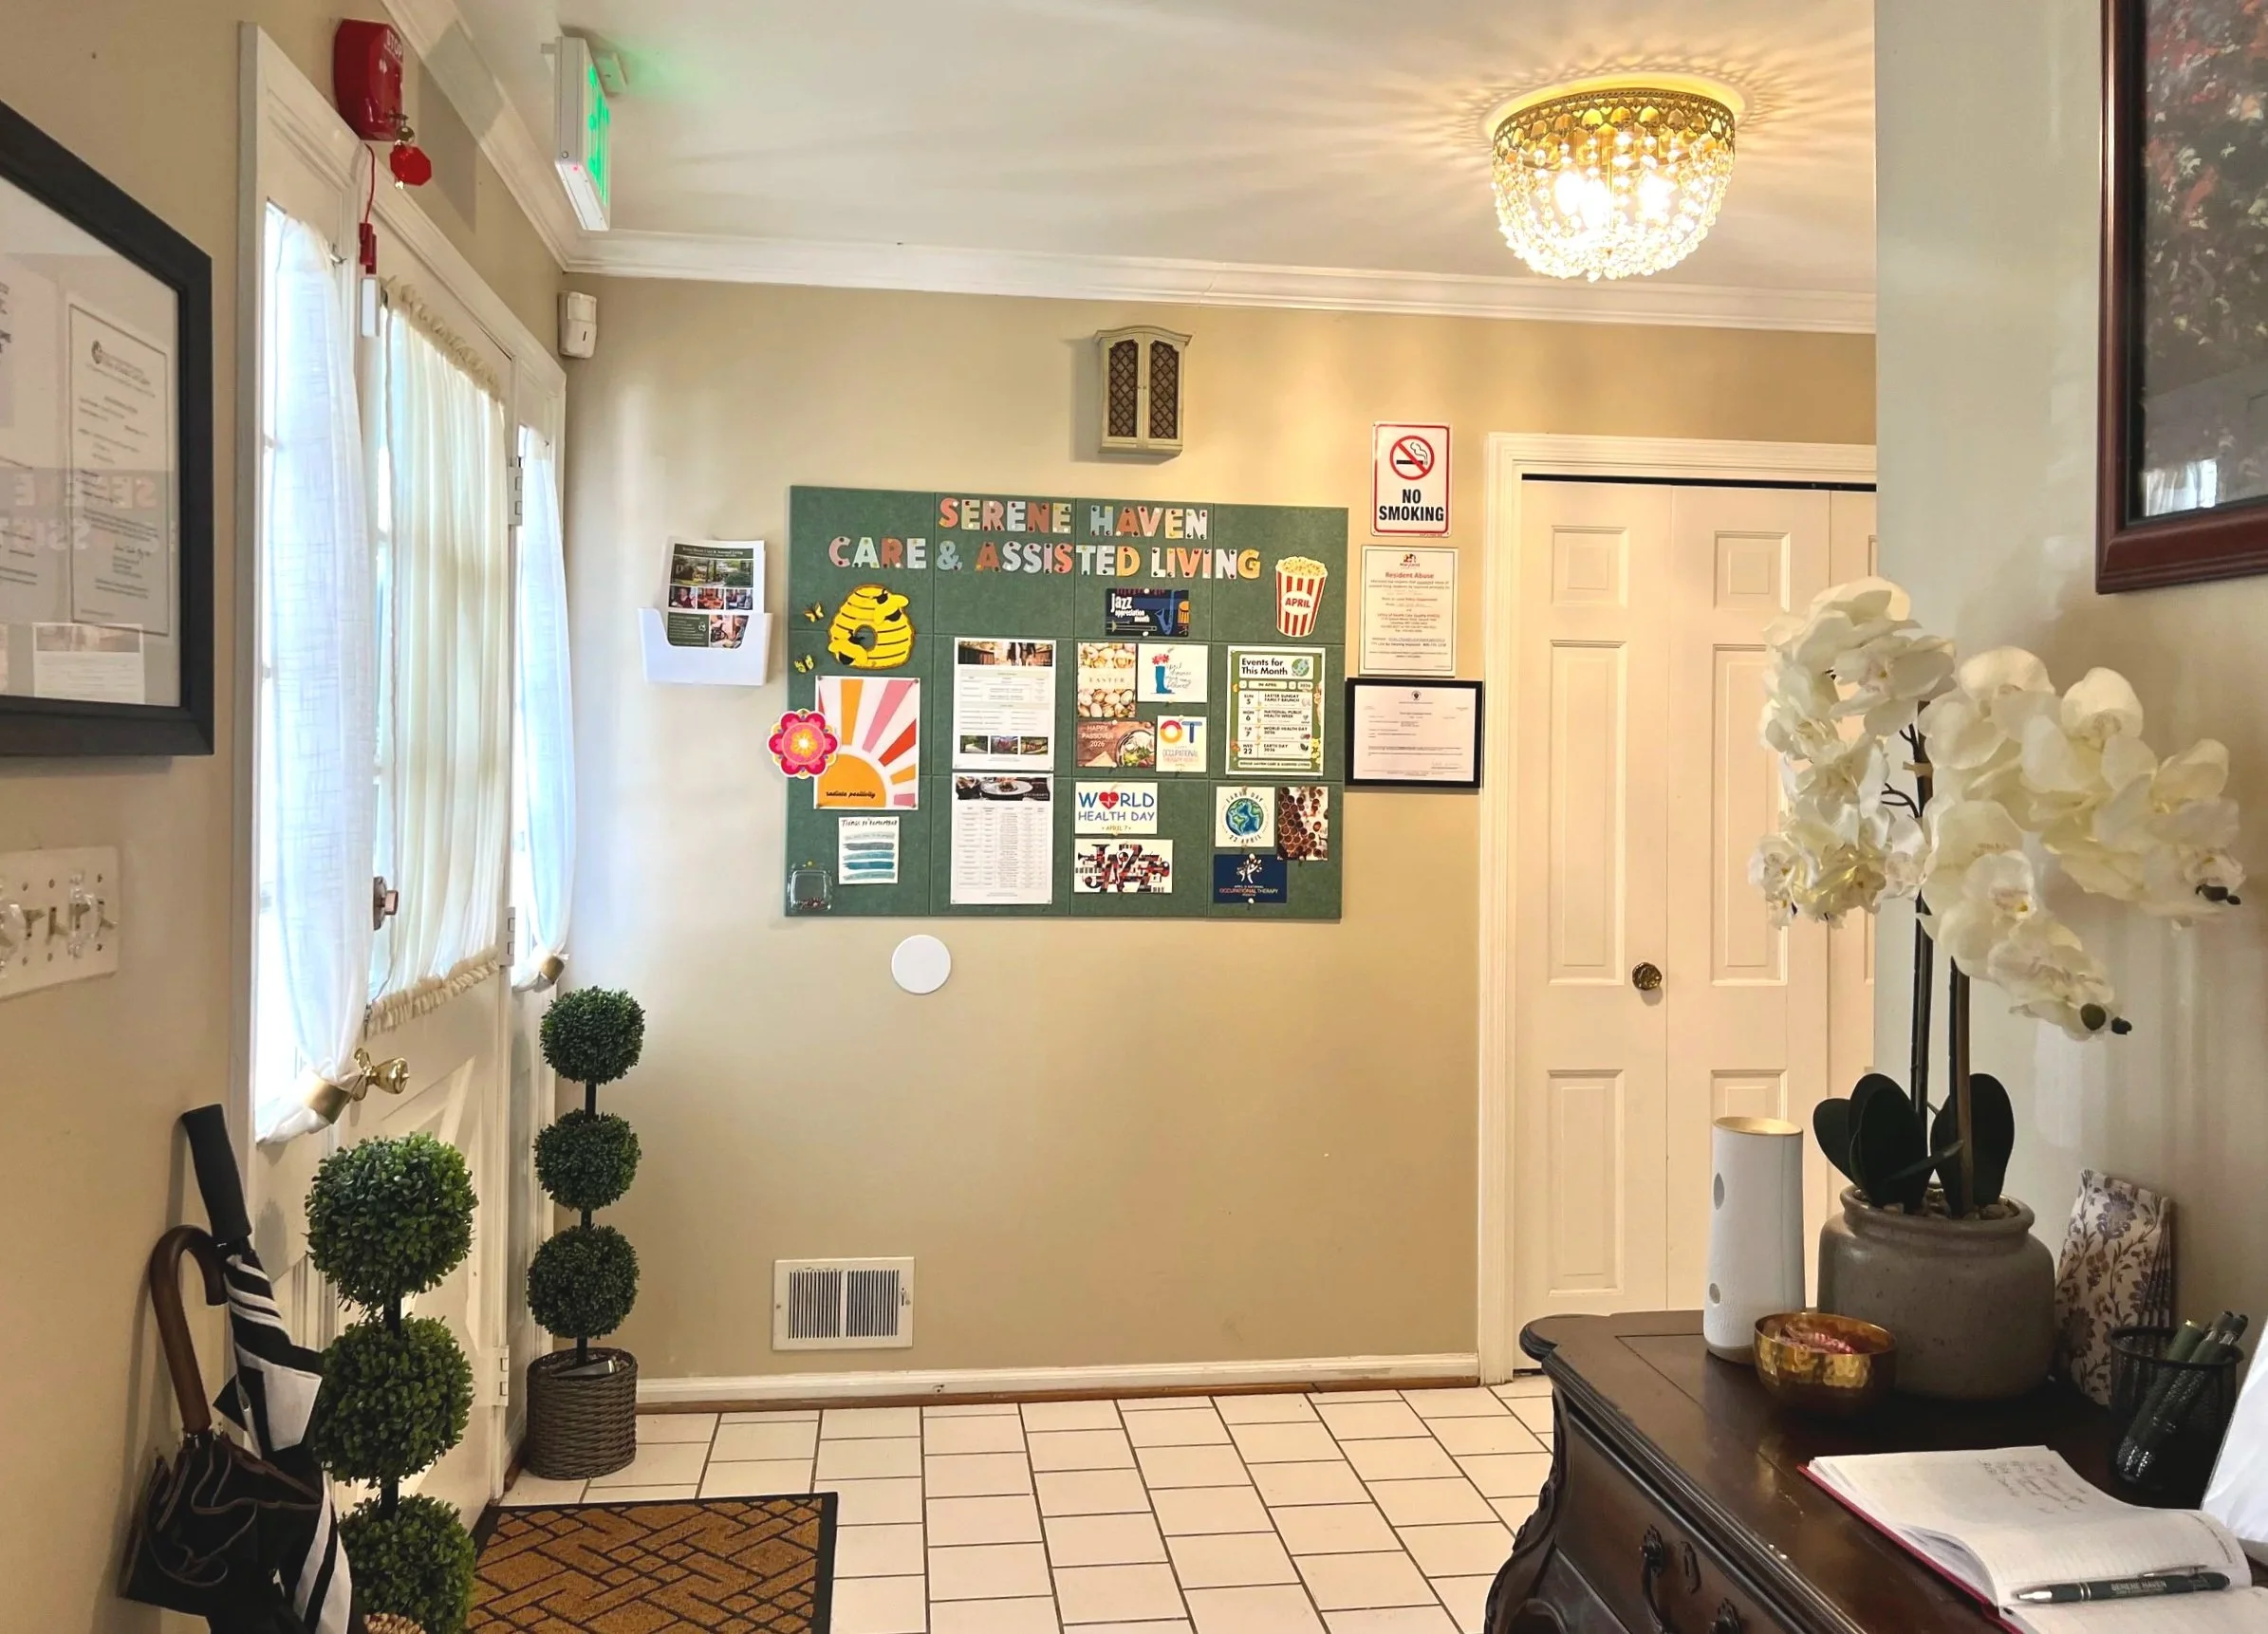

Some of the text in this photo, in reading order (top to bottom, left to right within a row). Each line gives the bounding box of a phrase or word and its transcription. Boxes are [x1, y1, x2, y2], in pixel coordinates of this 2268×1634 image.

[1402, 489, 1422, 504] NO
[939, 497, 1208, 540] SERENE HAVEN
[1379, 506, 1444, 521] SMOKING
[828, 535, 1261, 579] CARE & ASSISTED LIVING
[1110, 593, 1132, 613] jazz
[1285, 597, 1311, 608] APRIL
[1115, 609, 1145, 618] appreciation
[1242, 658, 1284, 666] Events for
[1081, 732, 1113, 740] PASSOVER
[1160, 719, 1202, 743] OT
[848, 790, 876, 799] positivity
[1251, 792, 1263, 803] DAY
[1078, 811, 1155, 821] HEALTH DAY
[1229, 834, 1262, 844] 22 APRIL
